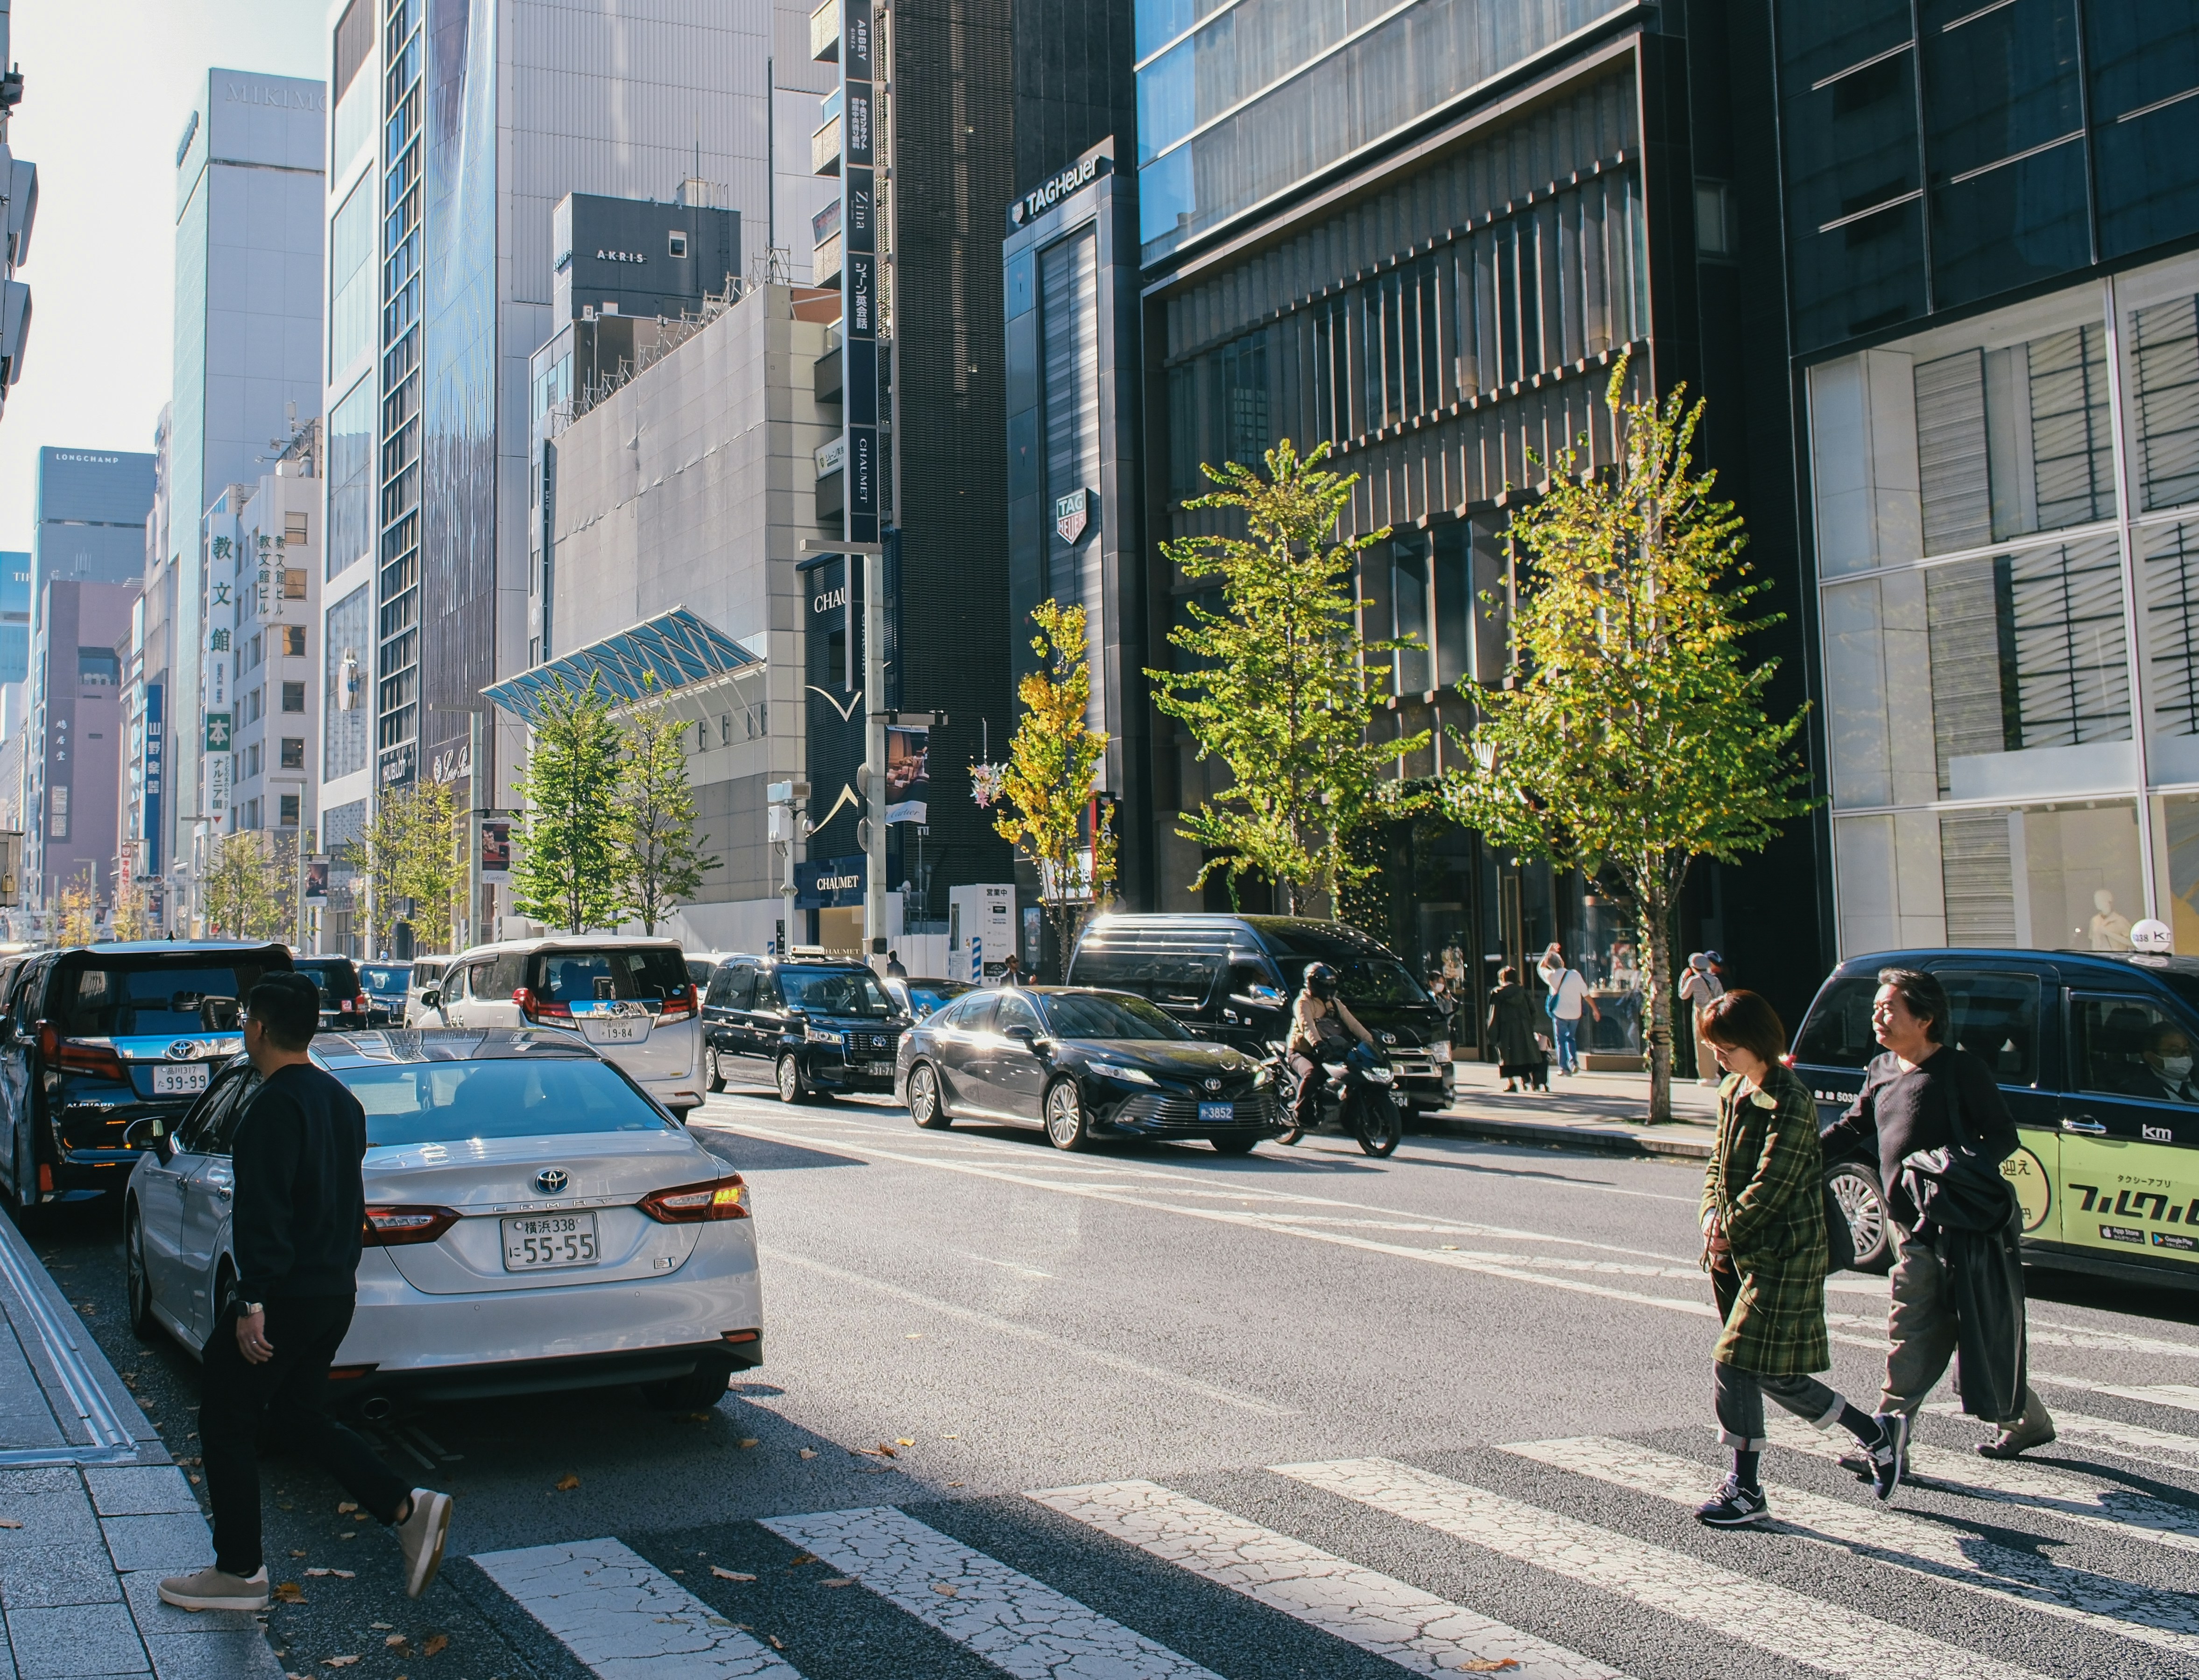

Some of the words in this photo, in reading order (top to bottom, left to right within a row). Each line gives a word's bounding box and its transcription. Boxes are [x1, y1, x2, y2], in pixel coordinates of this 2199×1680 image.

[857, 20, 866, 61] ABBEY
[856, 191, 868, 229] Zina
[597, 250, 643, 263] AKRIS
[856, 263, 868, 330] シェーン英会話
[56, 453, 119, 464] LONGCHAMP
[1059, 495, 1083, 515] TAG
[1059, 514, 1084, 540] HEUER
[259, 535, 271, 615] 教文館ビル
[211, 536, 233, 653] 教文館
[209, 719, 229, 746] 本
[148, 722, 161, 794] 山野楽器
[383, 759, 406, 783] HUBLOT
[212, 759, 223, 810] ナルニア国
[891, 808, 920, 818] Cartier
[817, 875, 859, 890] CHAUMET
[608, 1028, 632, 1038] 19-84
[167, 1066, 197, 1075] 品川317
[167, 1075, 206, 1090] 99-99
[2142, 1123, 2171, 1140] km
[2117, 1174, 2171, 1188] タクシーアプリ
[493, 1197, 613, 1212] CAMRY
[524, 1218, 576, 1235] 横浜338
[2113, 1227, 2125, 1235] App
[2125, 1228, 2140, 1237] Store
[2164, 1235, 2182, 1244] Google
[509, 1246, 521, 1258] に
[523, 1233, 594, 1264] 55-55
[1731, 1496, 1754, 1514] N
